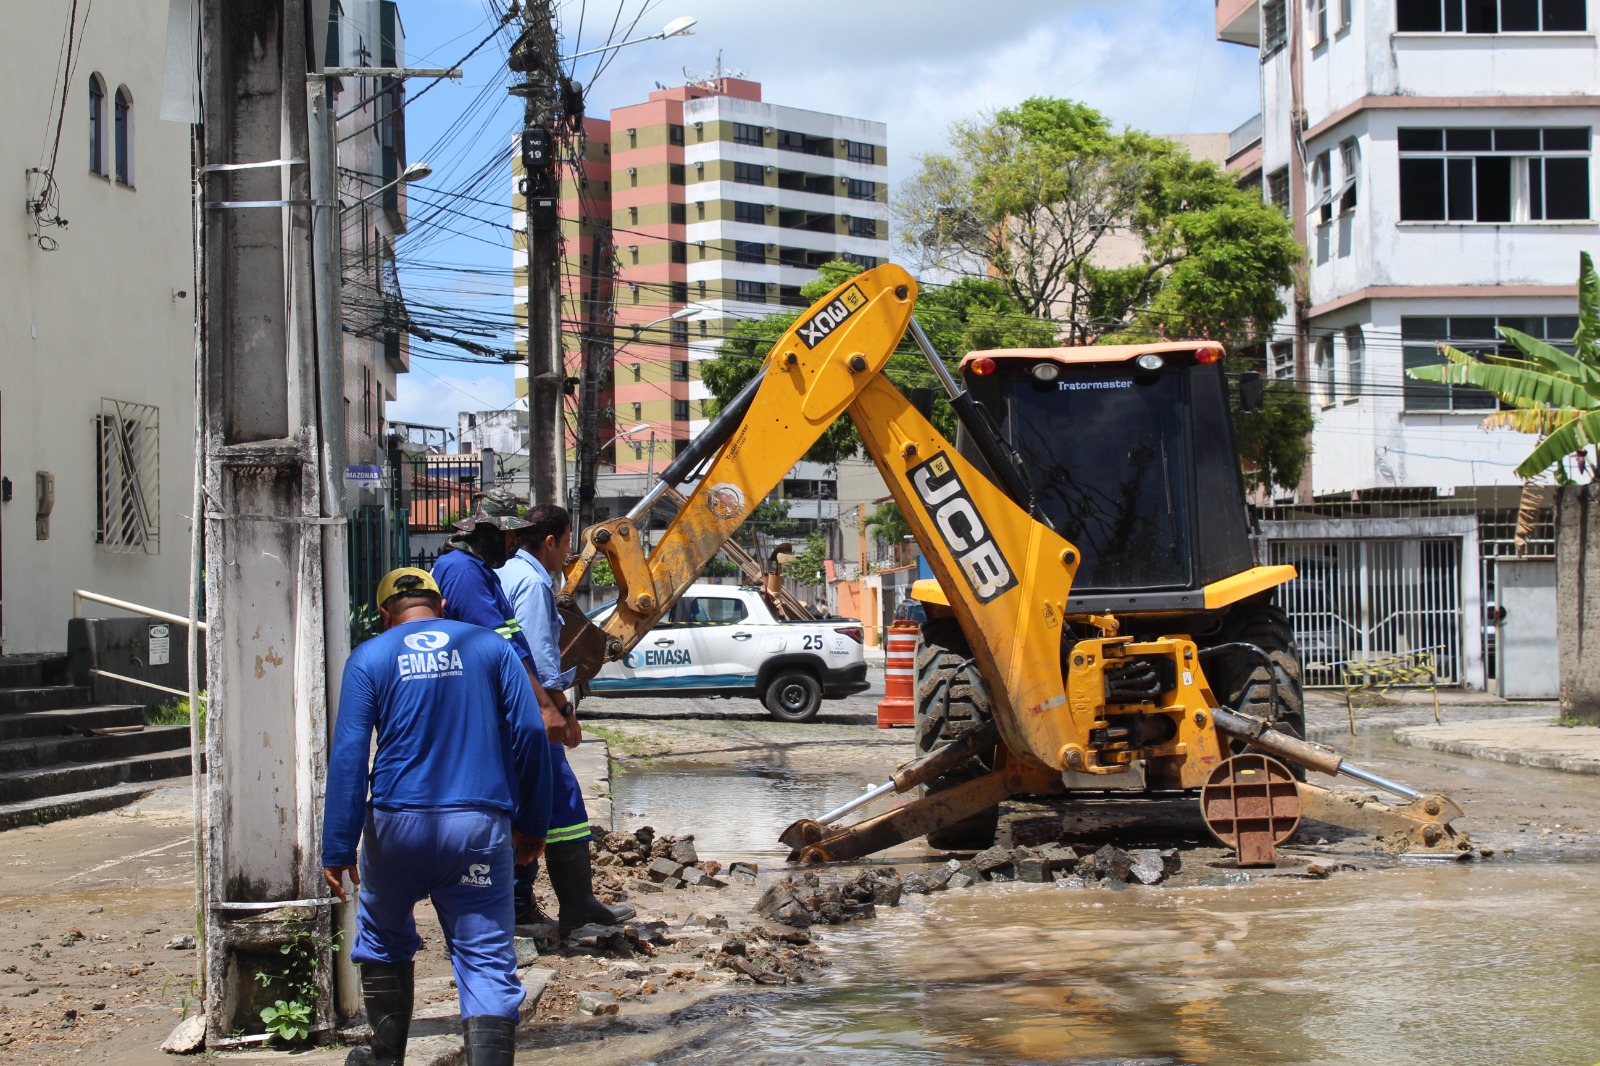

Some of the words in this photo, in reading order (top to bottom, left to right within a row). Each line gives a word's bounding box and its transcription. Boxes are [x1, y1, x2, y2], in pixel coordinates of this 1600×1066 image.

[528, 150, 542, 158] 19
[799, 300, 848, 346] 3CX
[1058, 381, 1132, 390] Tratormaster
[726, 424, 748, 460] Tratormaster
[914, 466, 1010, 598] JCB
[803, 635, 823, 650] 25
[398, 649, 464, 676] EMASA
[645, 649, 692, 665] EMASA
